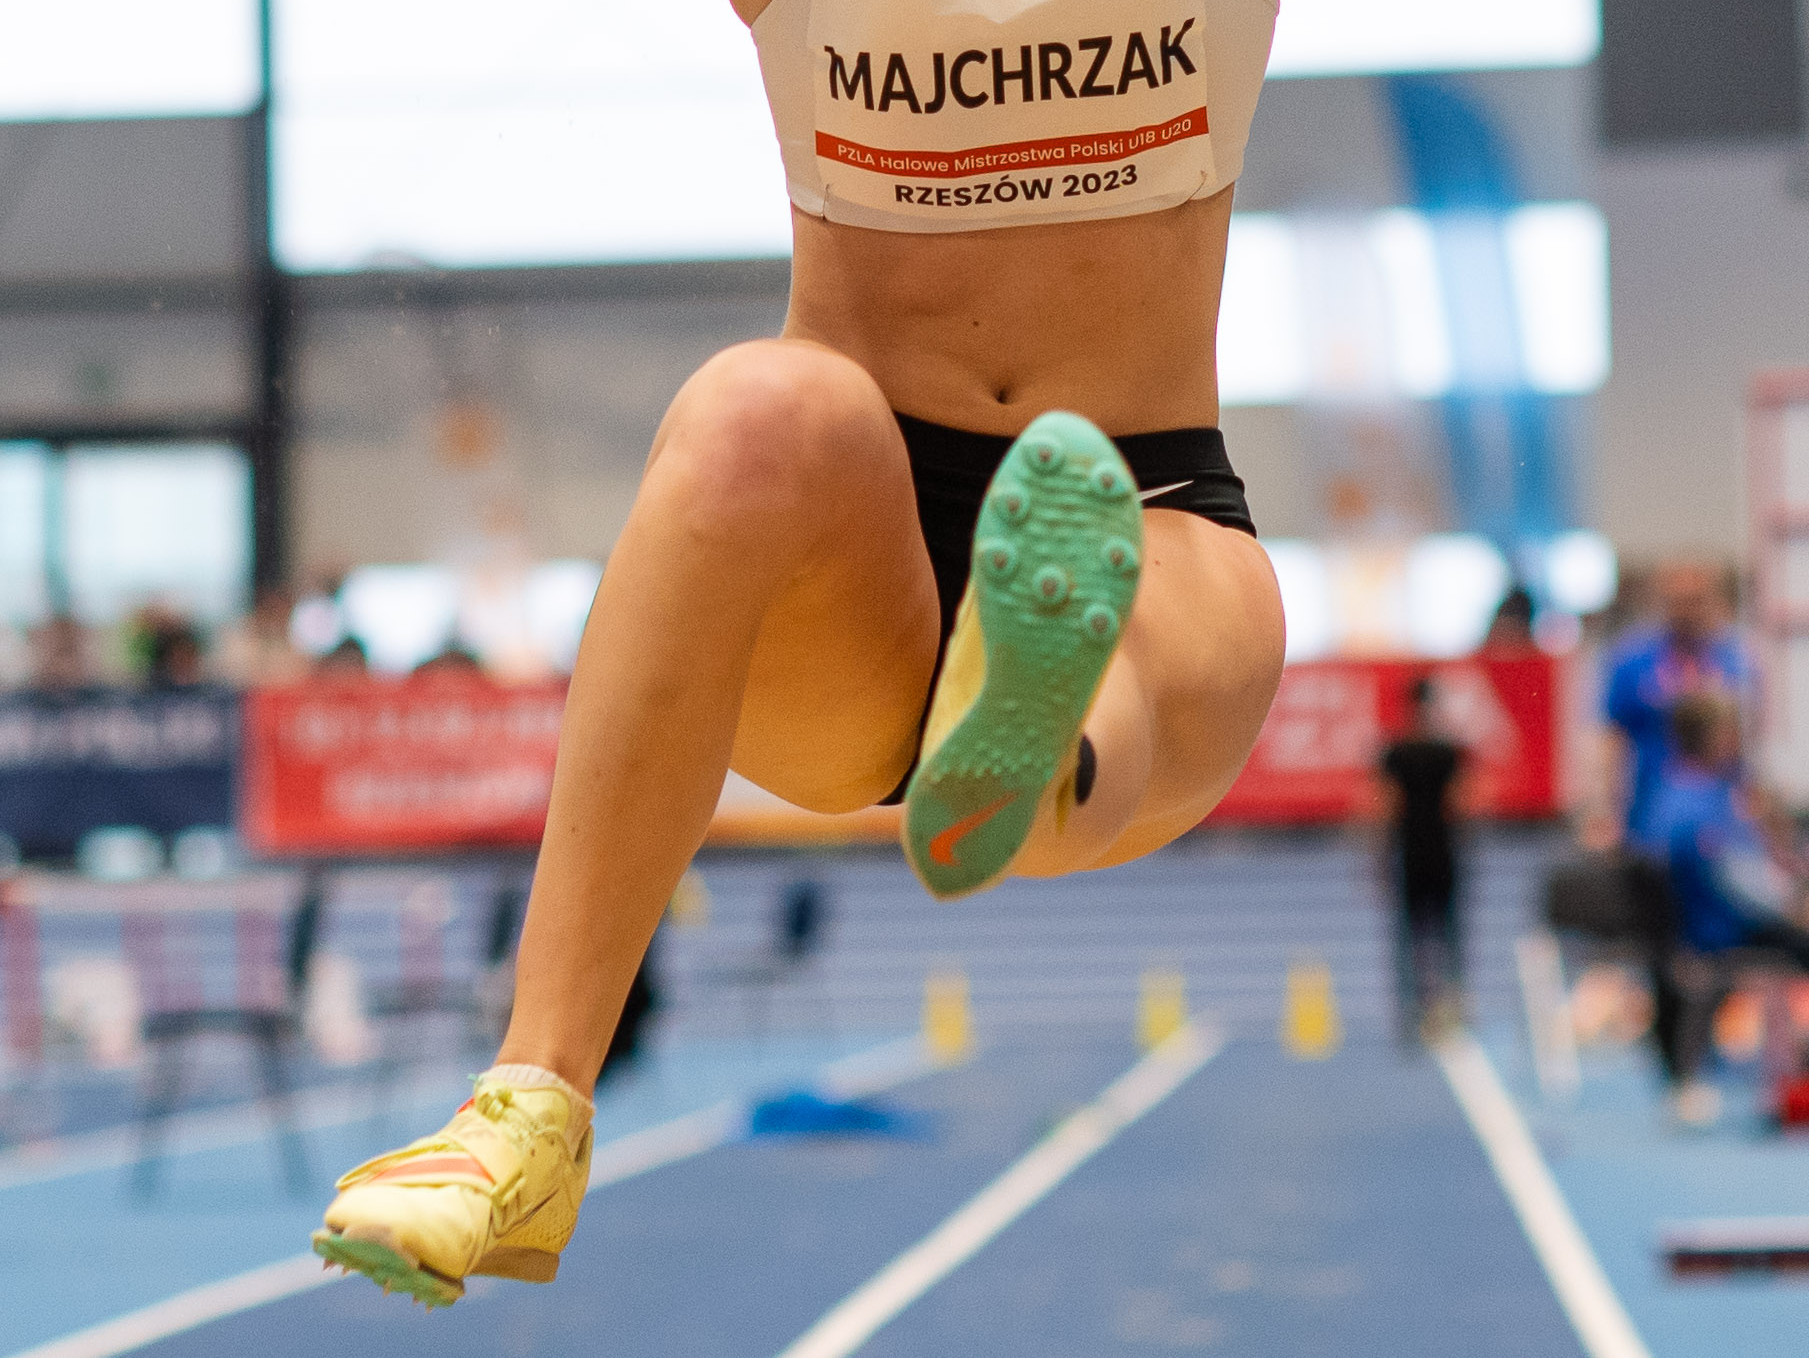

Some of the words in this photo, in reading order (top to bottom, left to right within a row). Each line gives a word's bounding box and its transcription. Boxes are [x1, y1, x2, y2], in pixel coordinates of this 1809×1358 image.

[824, 17, 1198, 115] MAJCHRZAK
[837, 144, 875, 167] PZLA
[880, 157, 949, 173] Halowe
[954, 145, 1065, 171] Mistrzostwa
[1070, 138, 1124, 156] Polski
[1129, 131, 1156, 149] U18
[1161, 119, 1192, 141] U20
[895, 175, 1053, 207] RZESZÓW
[1062, 165, 1138, 197] 2023
